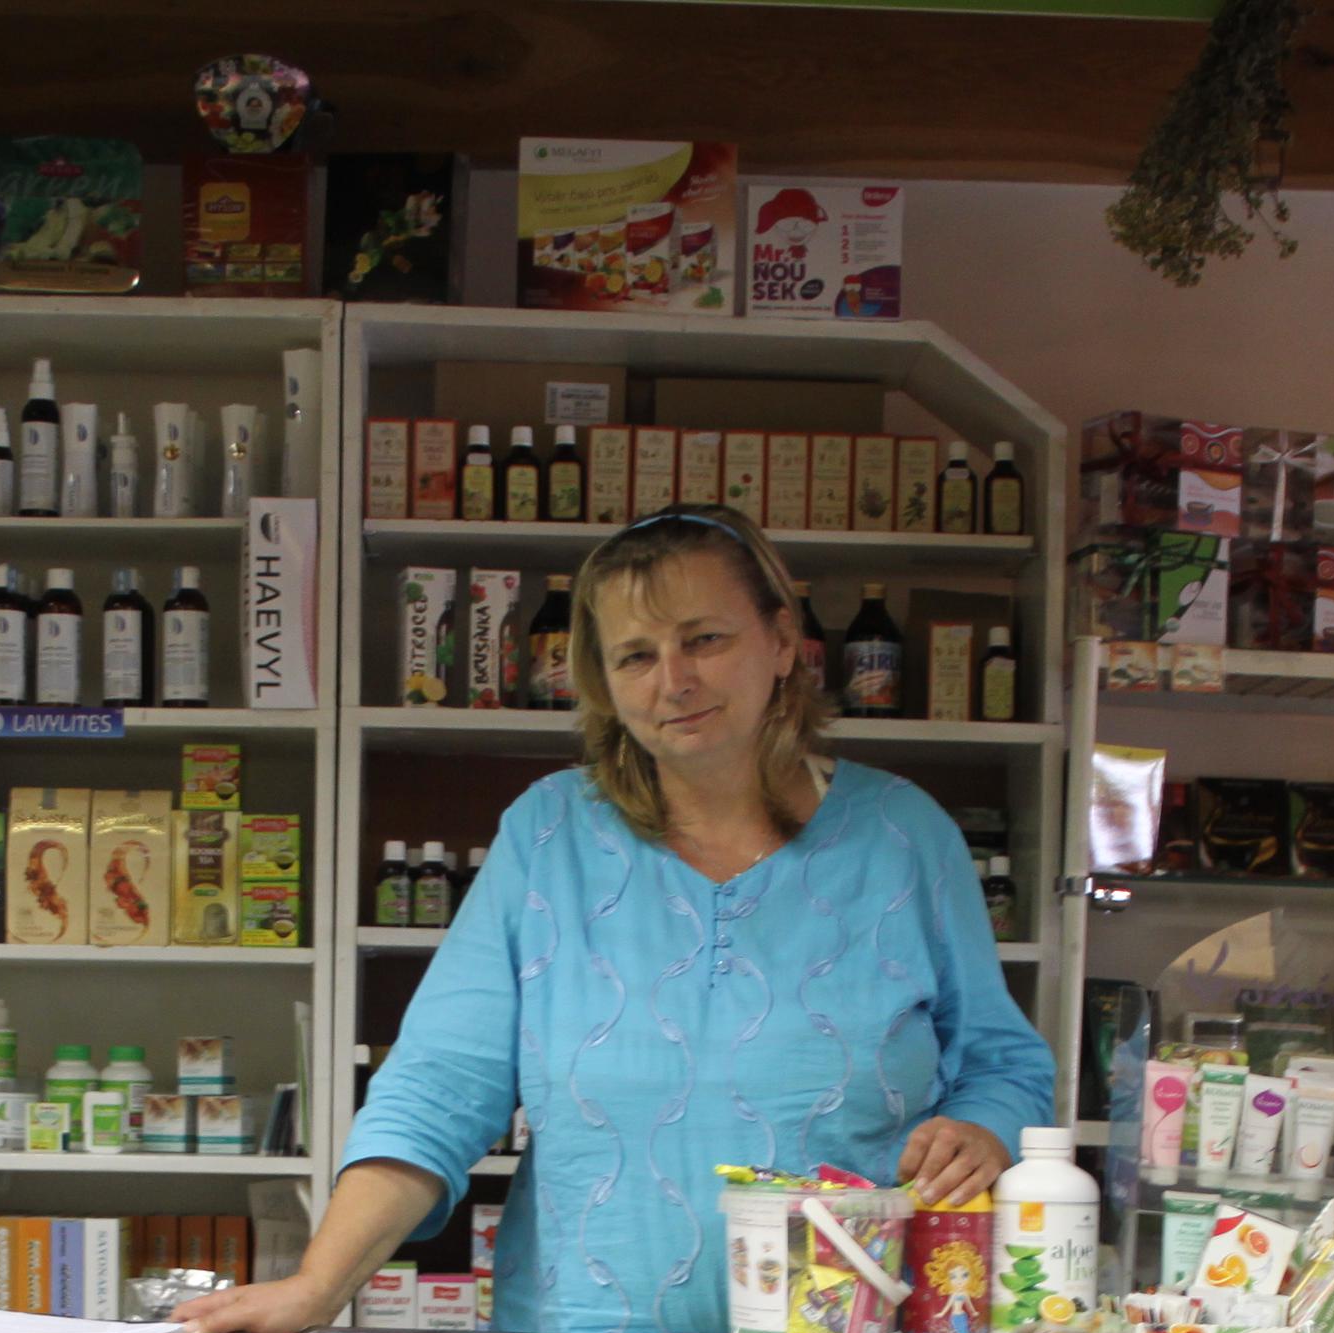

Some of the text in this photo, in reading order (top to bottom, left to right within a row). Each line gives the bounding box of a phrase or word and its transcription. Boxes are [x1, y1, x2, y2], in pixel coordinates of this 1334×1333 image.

[753, 282, 796, 301] SEK
[255, 555, 281, 698] HAEVYL
[11, 712, 114, 733] LAVYLITES
[1051, 1238, 1093, 1261] aloe
